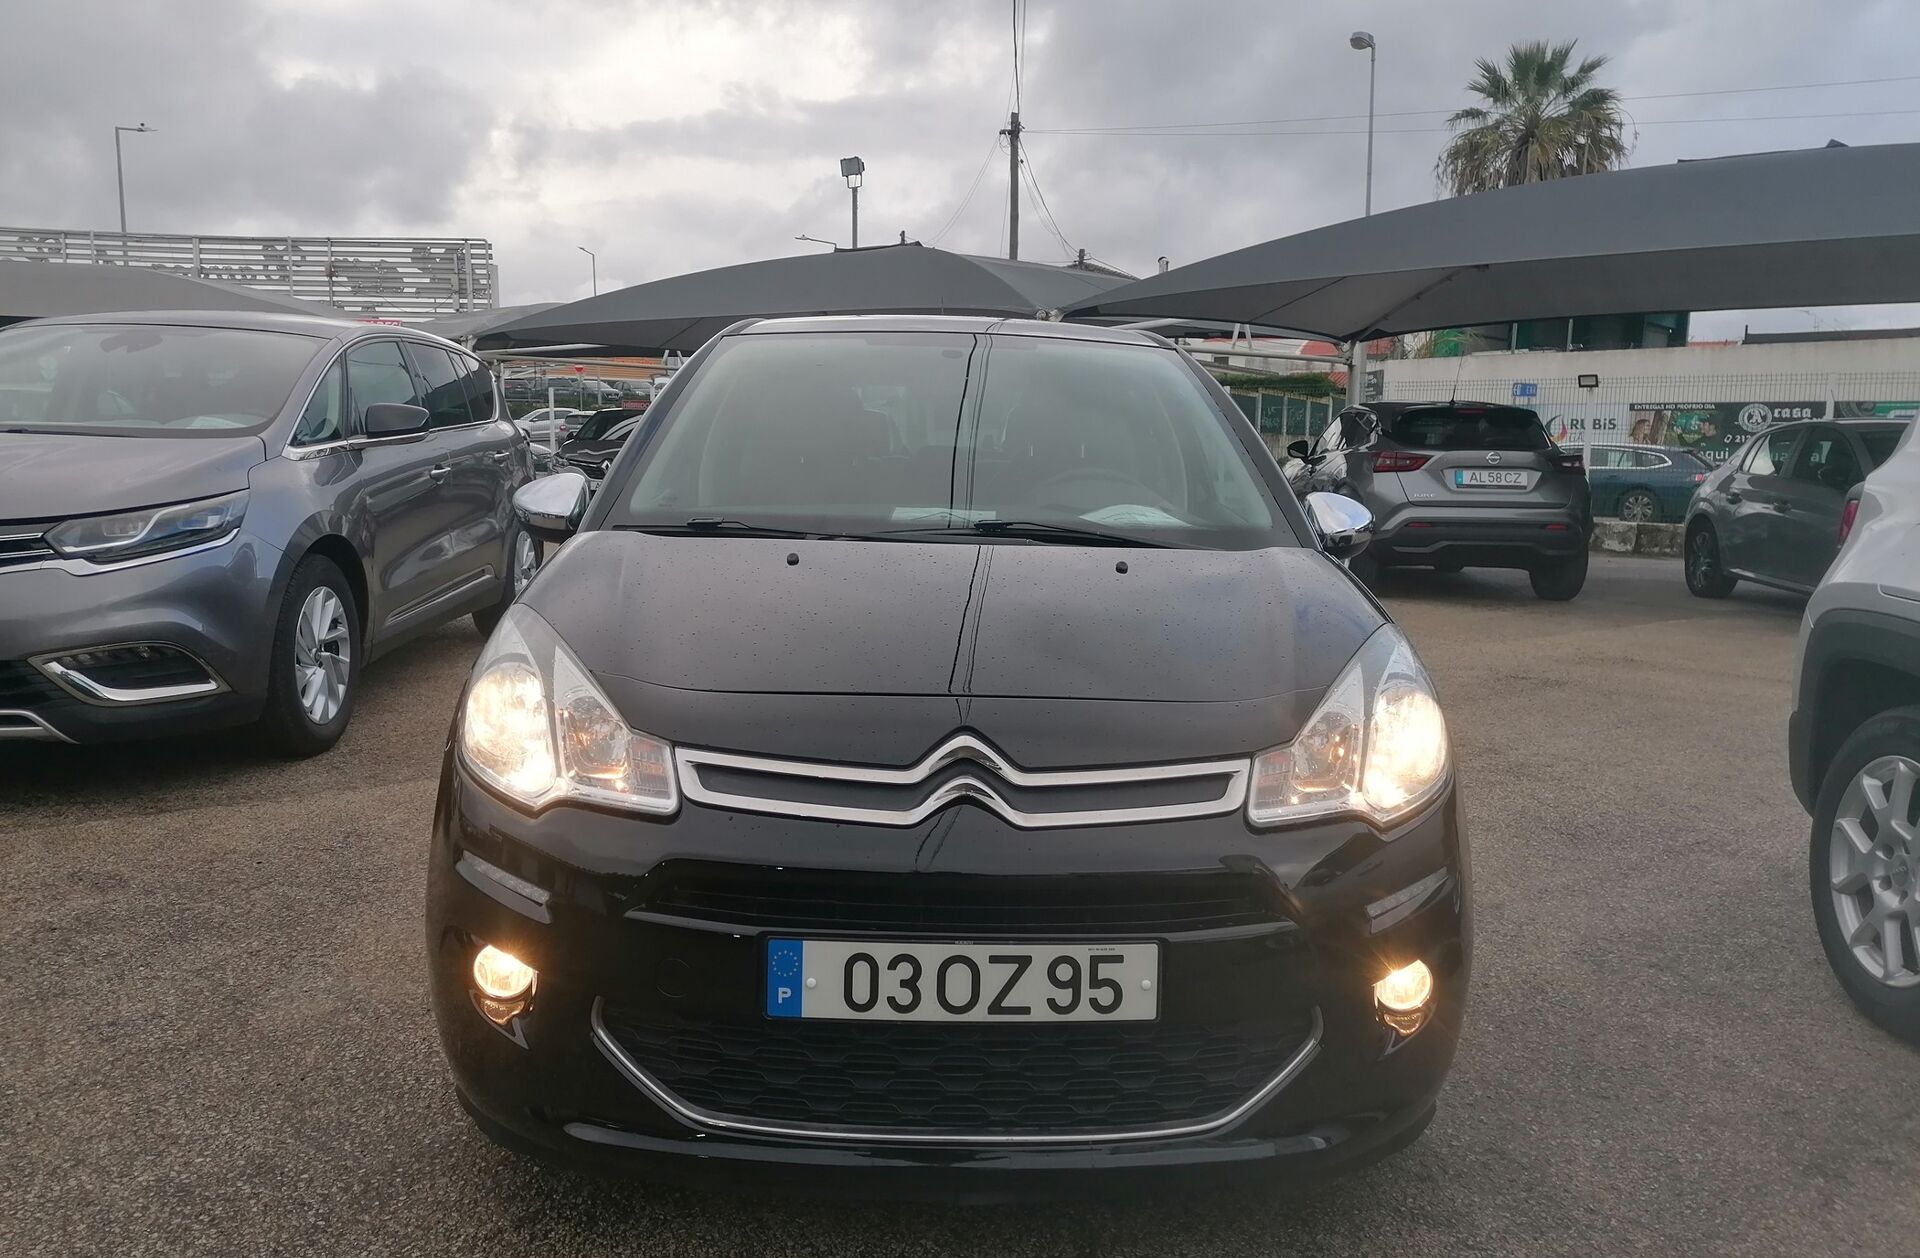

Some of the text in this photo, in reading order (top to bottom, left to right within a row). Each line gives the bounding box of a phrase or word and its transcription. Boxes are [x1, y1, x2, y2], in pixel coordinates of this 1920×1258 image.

[1773, 407, 1812, 418] casa
[1469, 471, 1522, 484] AL 58 CZ
[777, 987, 792, 1004] P
